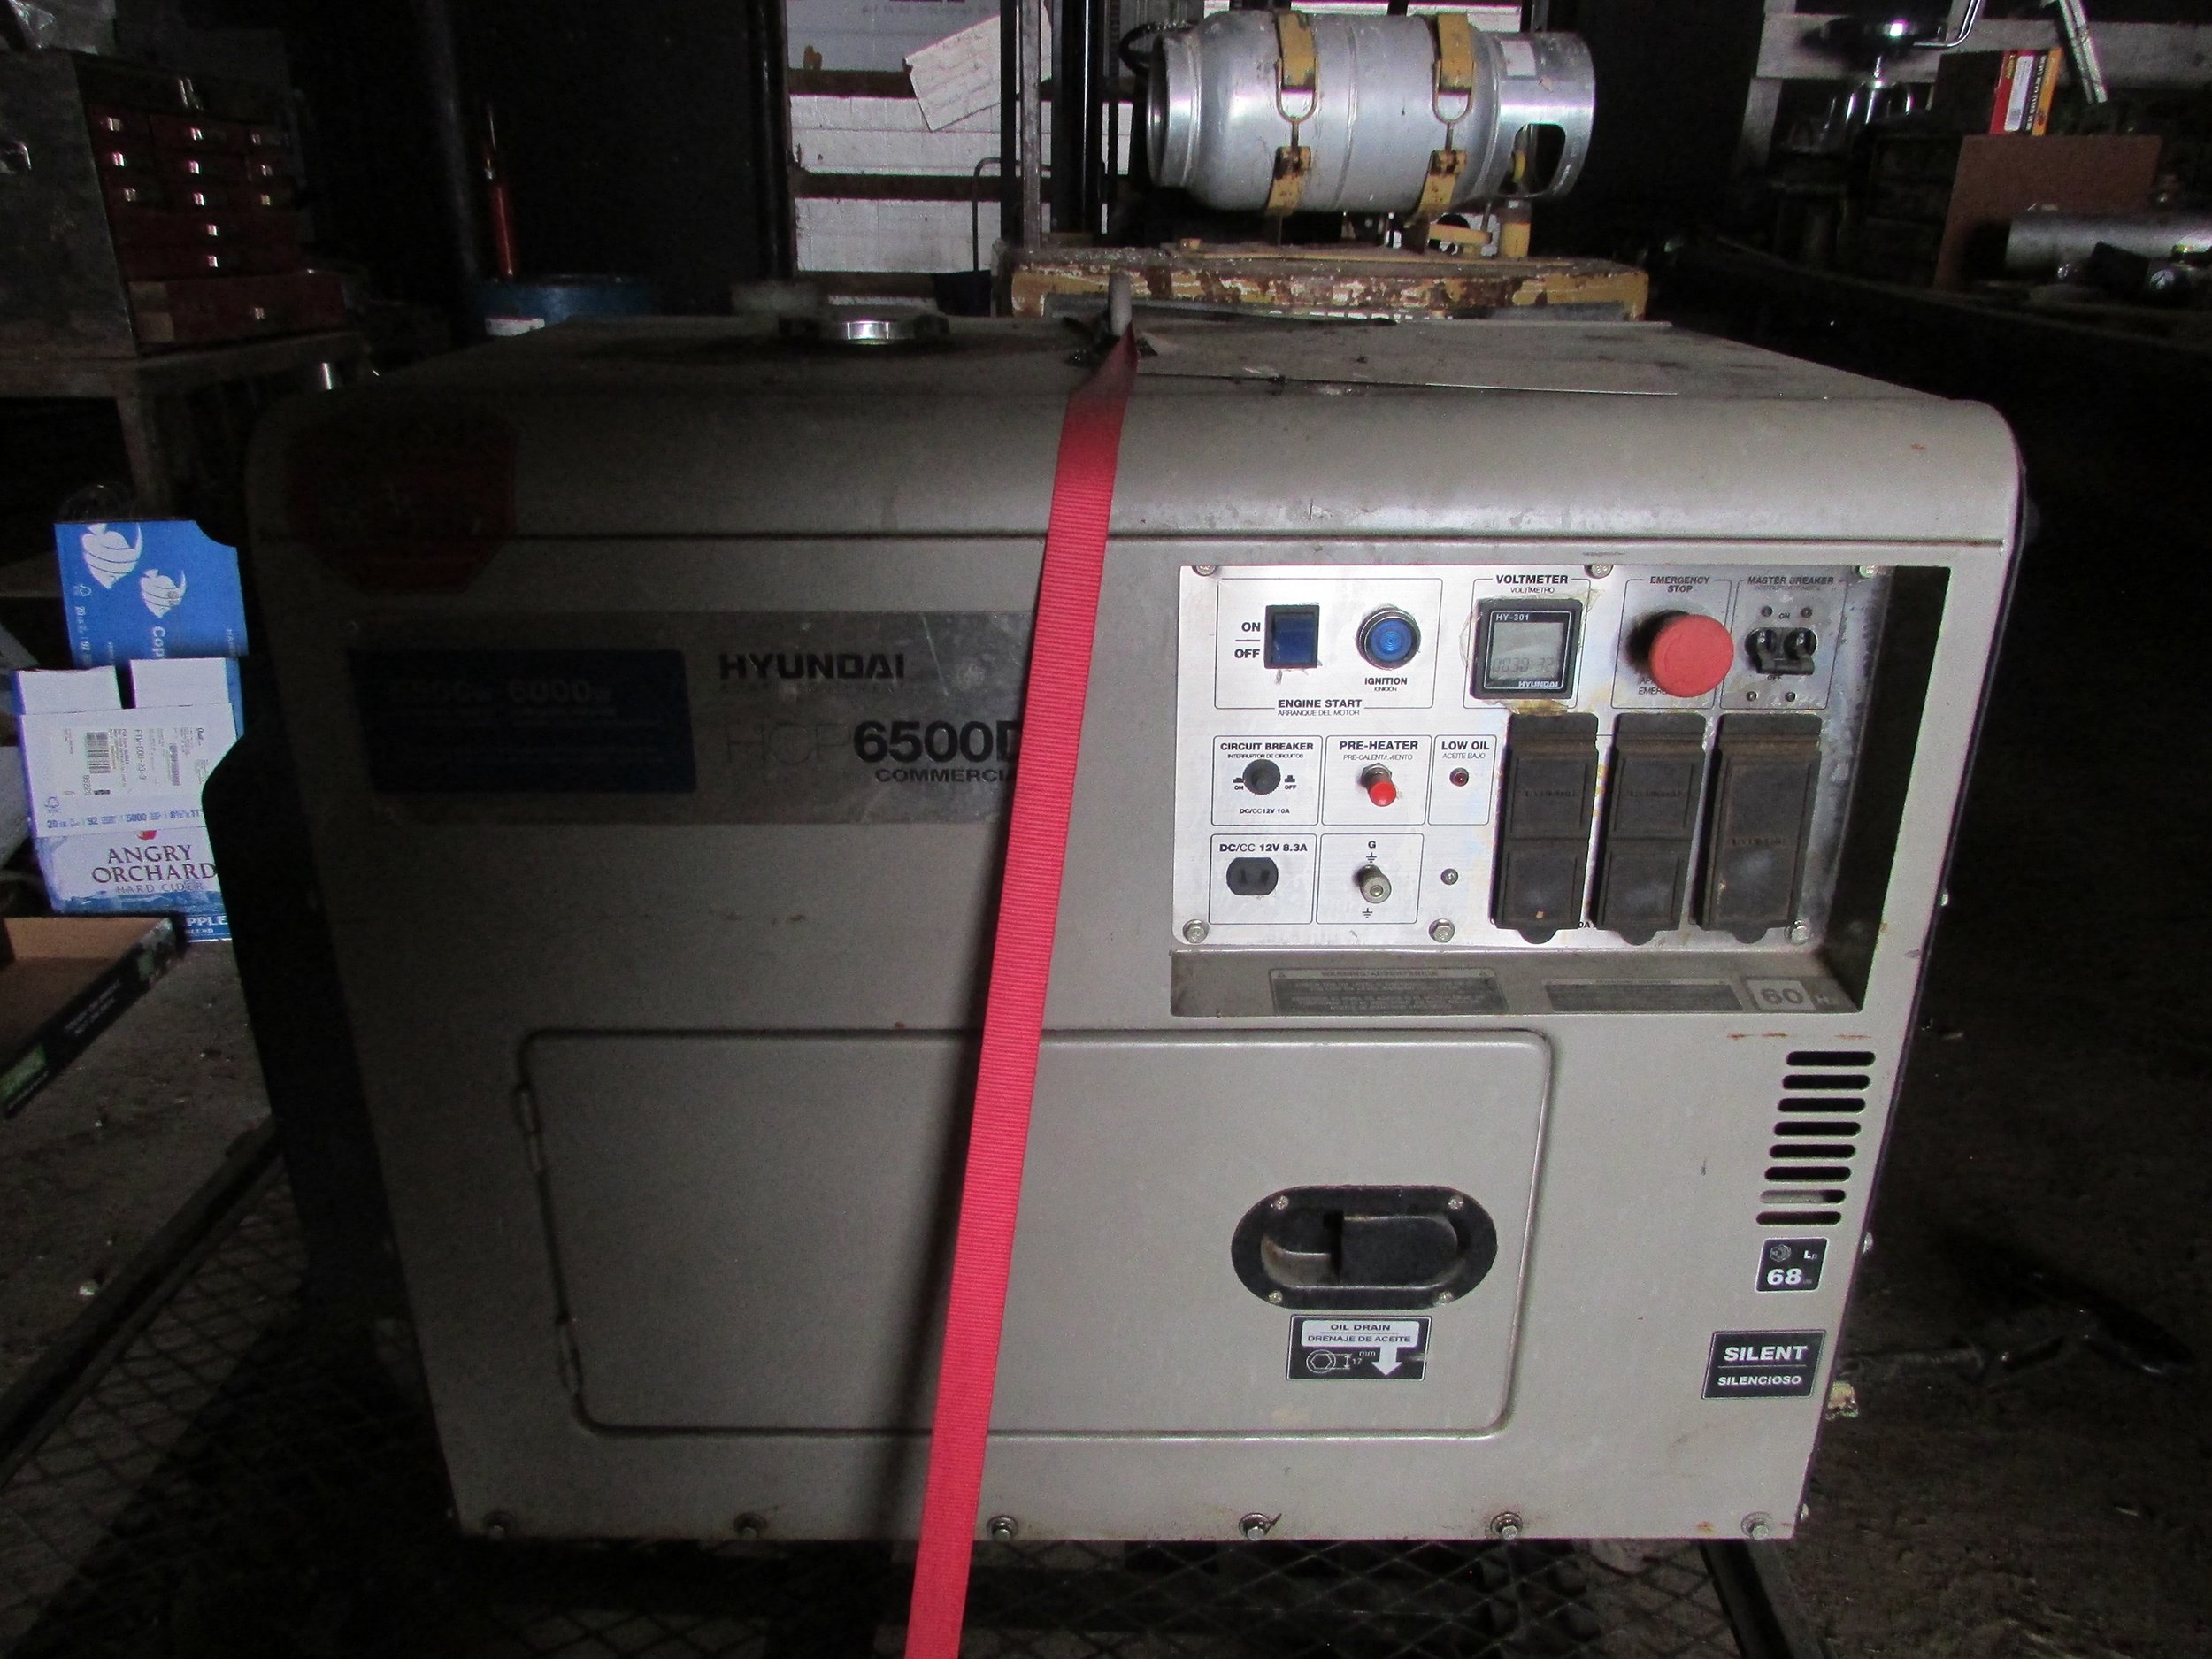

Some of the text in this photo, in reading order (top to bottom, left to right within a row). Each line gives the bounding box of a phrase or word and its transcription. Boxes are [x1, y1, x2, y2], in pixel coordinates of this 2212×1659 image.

[1495, 574, 1569, 584] VOLTMETER
[1649, 576, 1710, 585] EMERGENCY
[1747, 576, 1834, 586] MASTER BREAKER
[1240, 622, 1261, 633] ON
[1234, 649, 1261, 660] OFF
[719, 653, 904, 680] HYUNDAI
[1364, 677, 1408, 686] IGNITION
[1277, 699, 1363, 709] ENGINE START
[1339, 740, 1419, 751] PRE-HEATER
[1440, 741, 1490, 750] LOW OIL
[1218, 843, 1309, 854] DC/CC 12V 8.3A
[1367, 841, 1377, 849] G
[107, 843, 192, 865] ANGRY
[91, 863, 218, 884] ORCHARD
[116, 882, 204, 895] HARD CIDER
[185, 915, 228, 926] PPLE
[1761, 987, 1804, 1006] 60
[1766, 1268, 1802, 1286] 68
[1724, 1345, 1809, 1363] SILENT
[1717, 1375, 1802, 1386] SILENCIOSO
